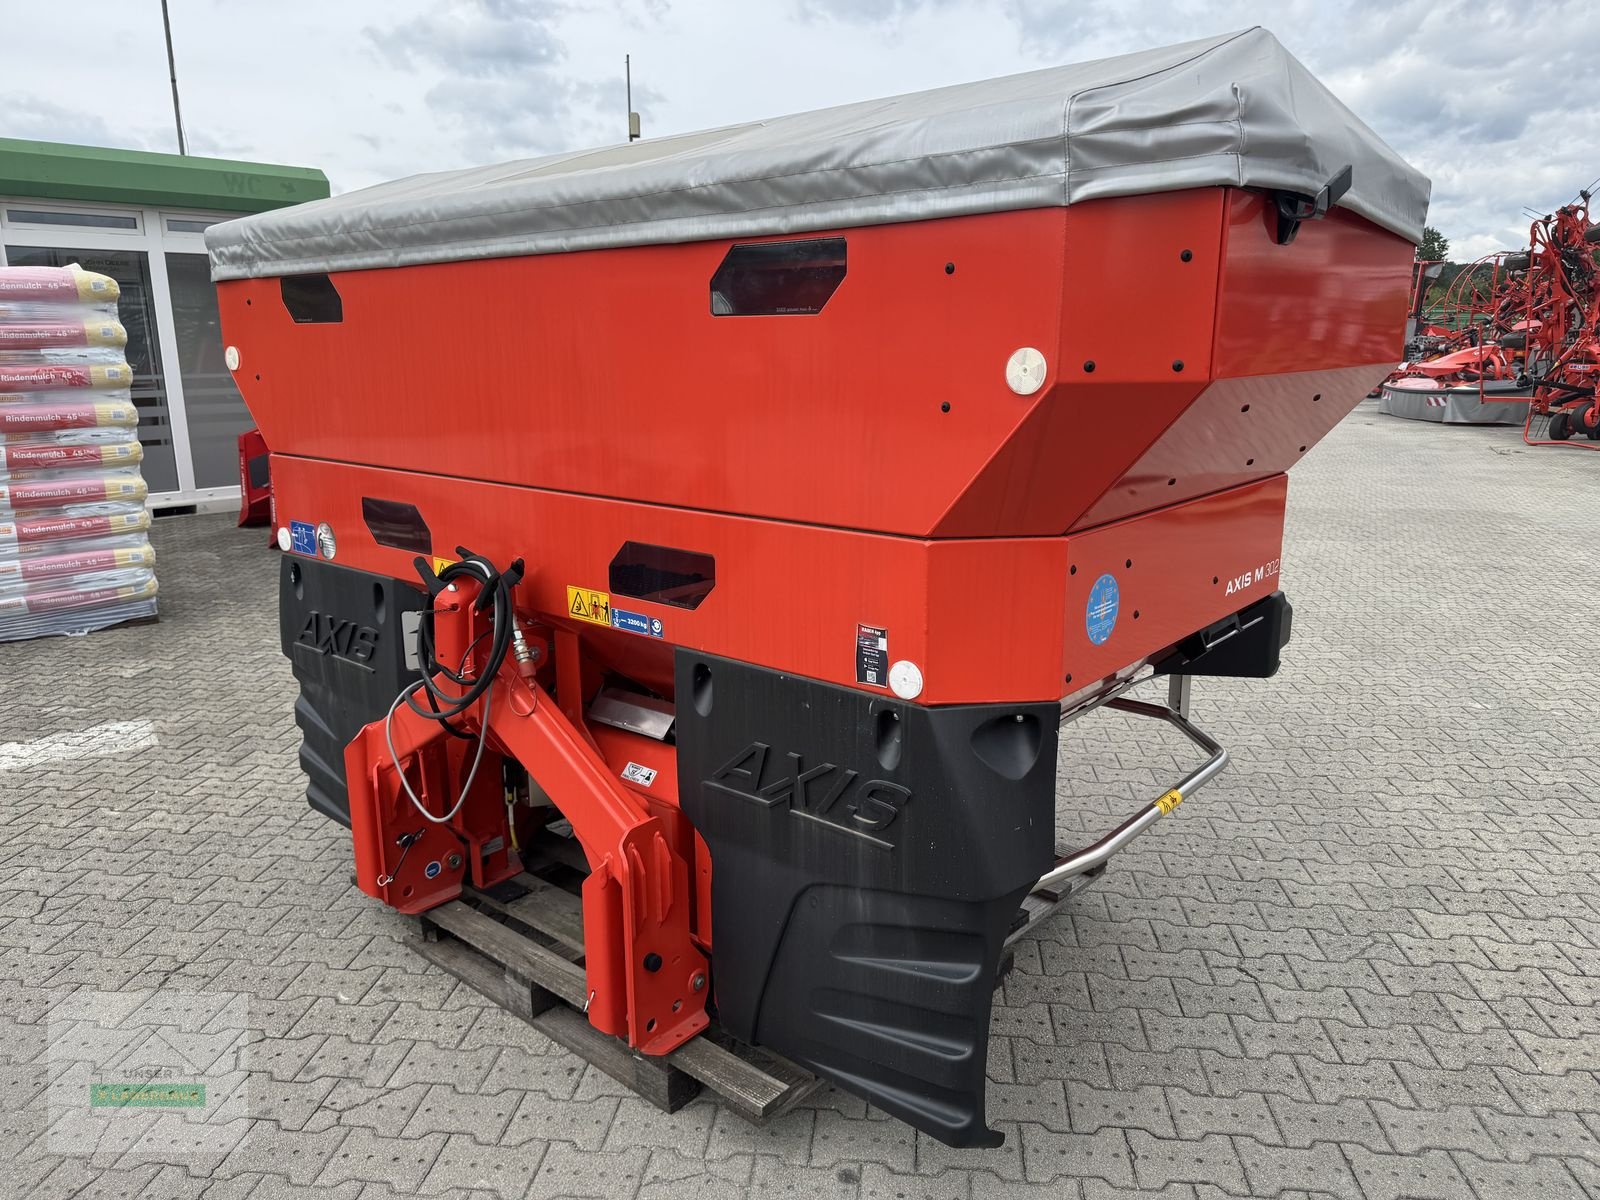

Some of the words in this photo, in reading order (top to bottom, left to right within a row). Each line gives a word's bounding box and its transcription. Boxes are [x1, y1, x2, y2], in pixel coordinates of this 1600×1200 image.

[223, 173, 262, 194] WC
[1, 372, 55, 381] Rindenmulch
[6, 413, 61, 422] Rindenmulch
[67, 412, 78, 420] 45
[13, 450, 67, 459] Rindenmulch
[73, 449, 84, 457] 45
[16, 488, 71, 498] Rindenmulch
[77, 487, 88, 495] 45
[23, 522, 76, 533] Rindenmulch
[28, 560, 81, 571] Rindenmulch
[1225, 571, 1252, 597] AXIS
[1254, 566, 1264, 583] M
[1265, 558, 1280, 578] 302
[627, 618, 640, 627] 3200
[300, 610, 380, 662] AXIS
[712, 740, 912, 832] AXIS
